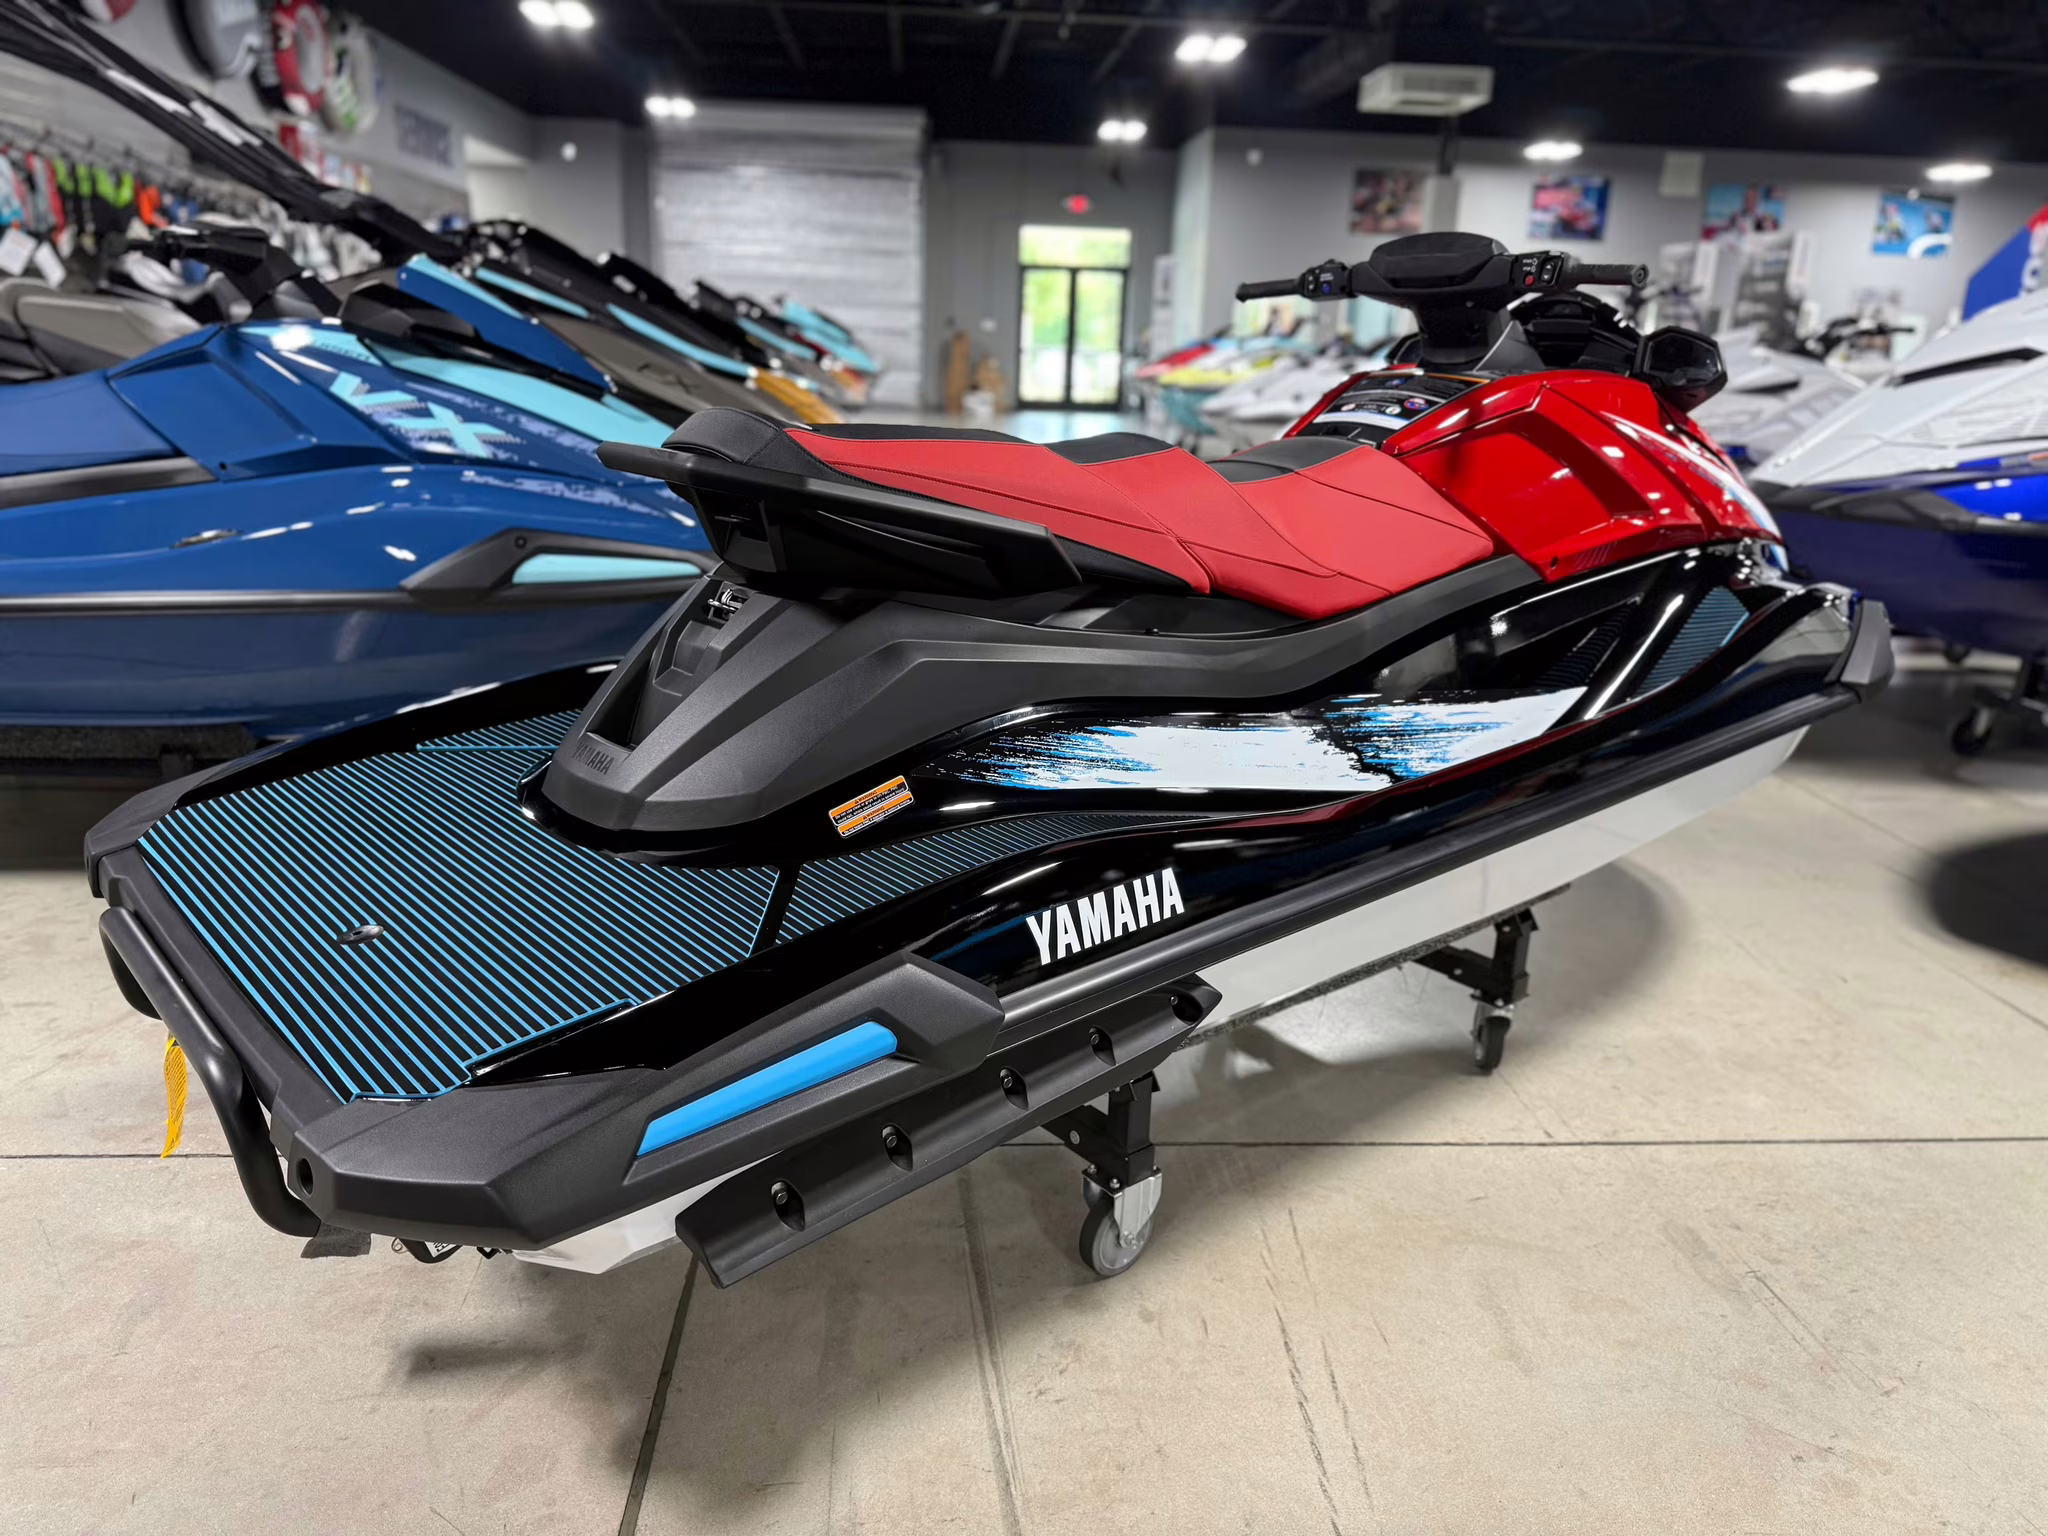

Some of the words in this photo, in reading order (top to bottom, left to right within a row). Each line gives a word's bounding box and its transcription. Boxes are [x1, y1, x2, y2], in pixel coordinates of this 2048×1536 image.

[330, 371, 508, 458] VX
[572, 742, 614, 775] YAMAHA
[858, 791, 878, 802] WARNING
[866, 806, 885, 818] WARNING
[1026, 867, 1184, 966] YAMAHA
